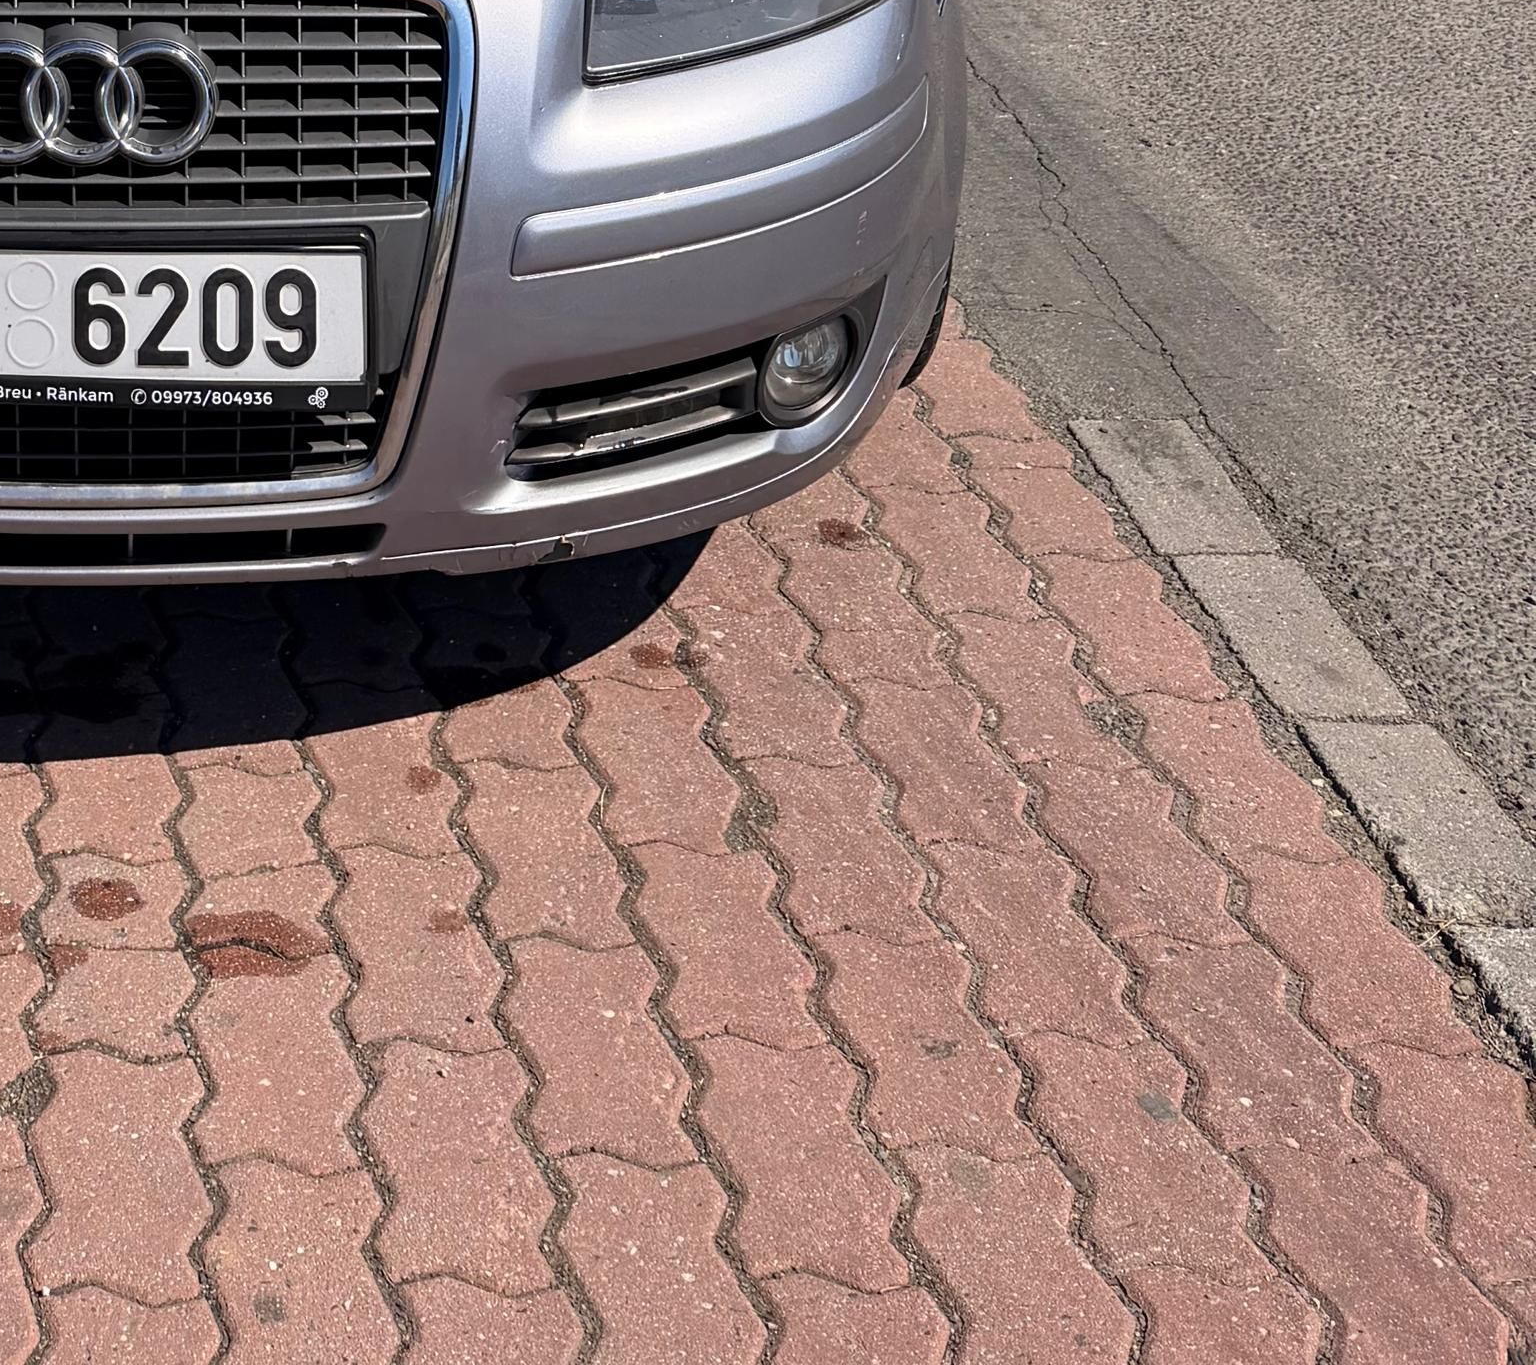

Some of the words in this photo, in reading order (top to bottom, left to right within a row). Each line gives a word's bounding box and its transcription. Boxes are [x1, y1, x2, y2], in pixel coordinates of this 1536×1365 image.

[73, 267, 318, 369] 6209
[46, 386, 114, 403] Ränkam
[151, 389, 273, 407] 09973/804936
